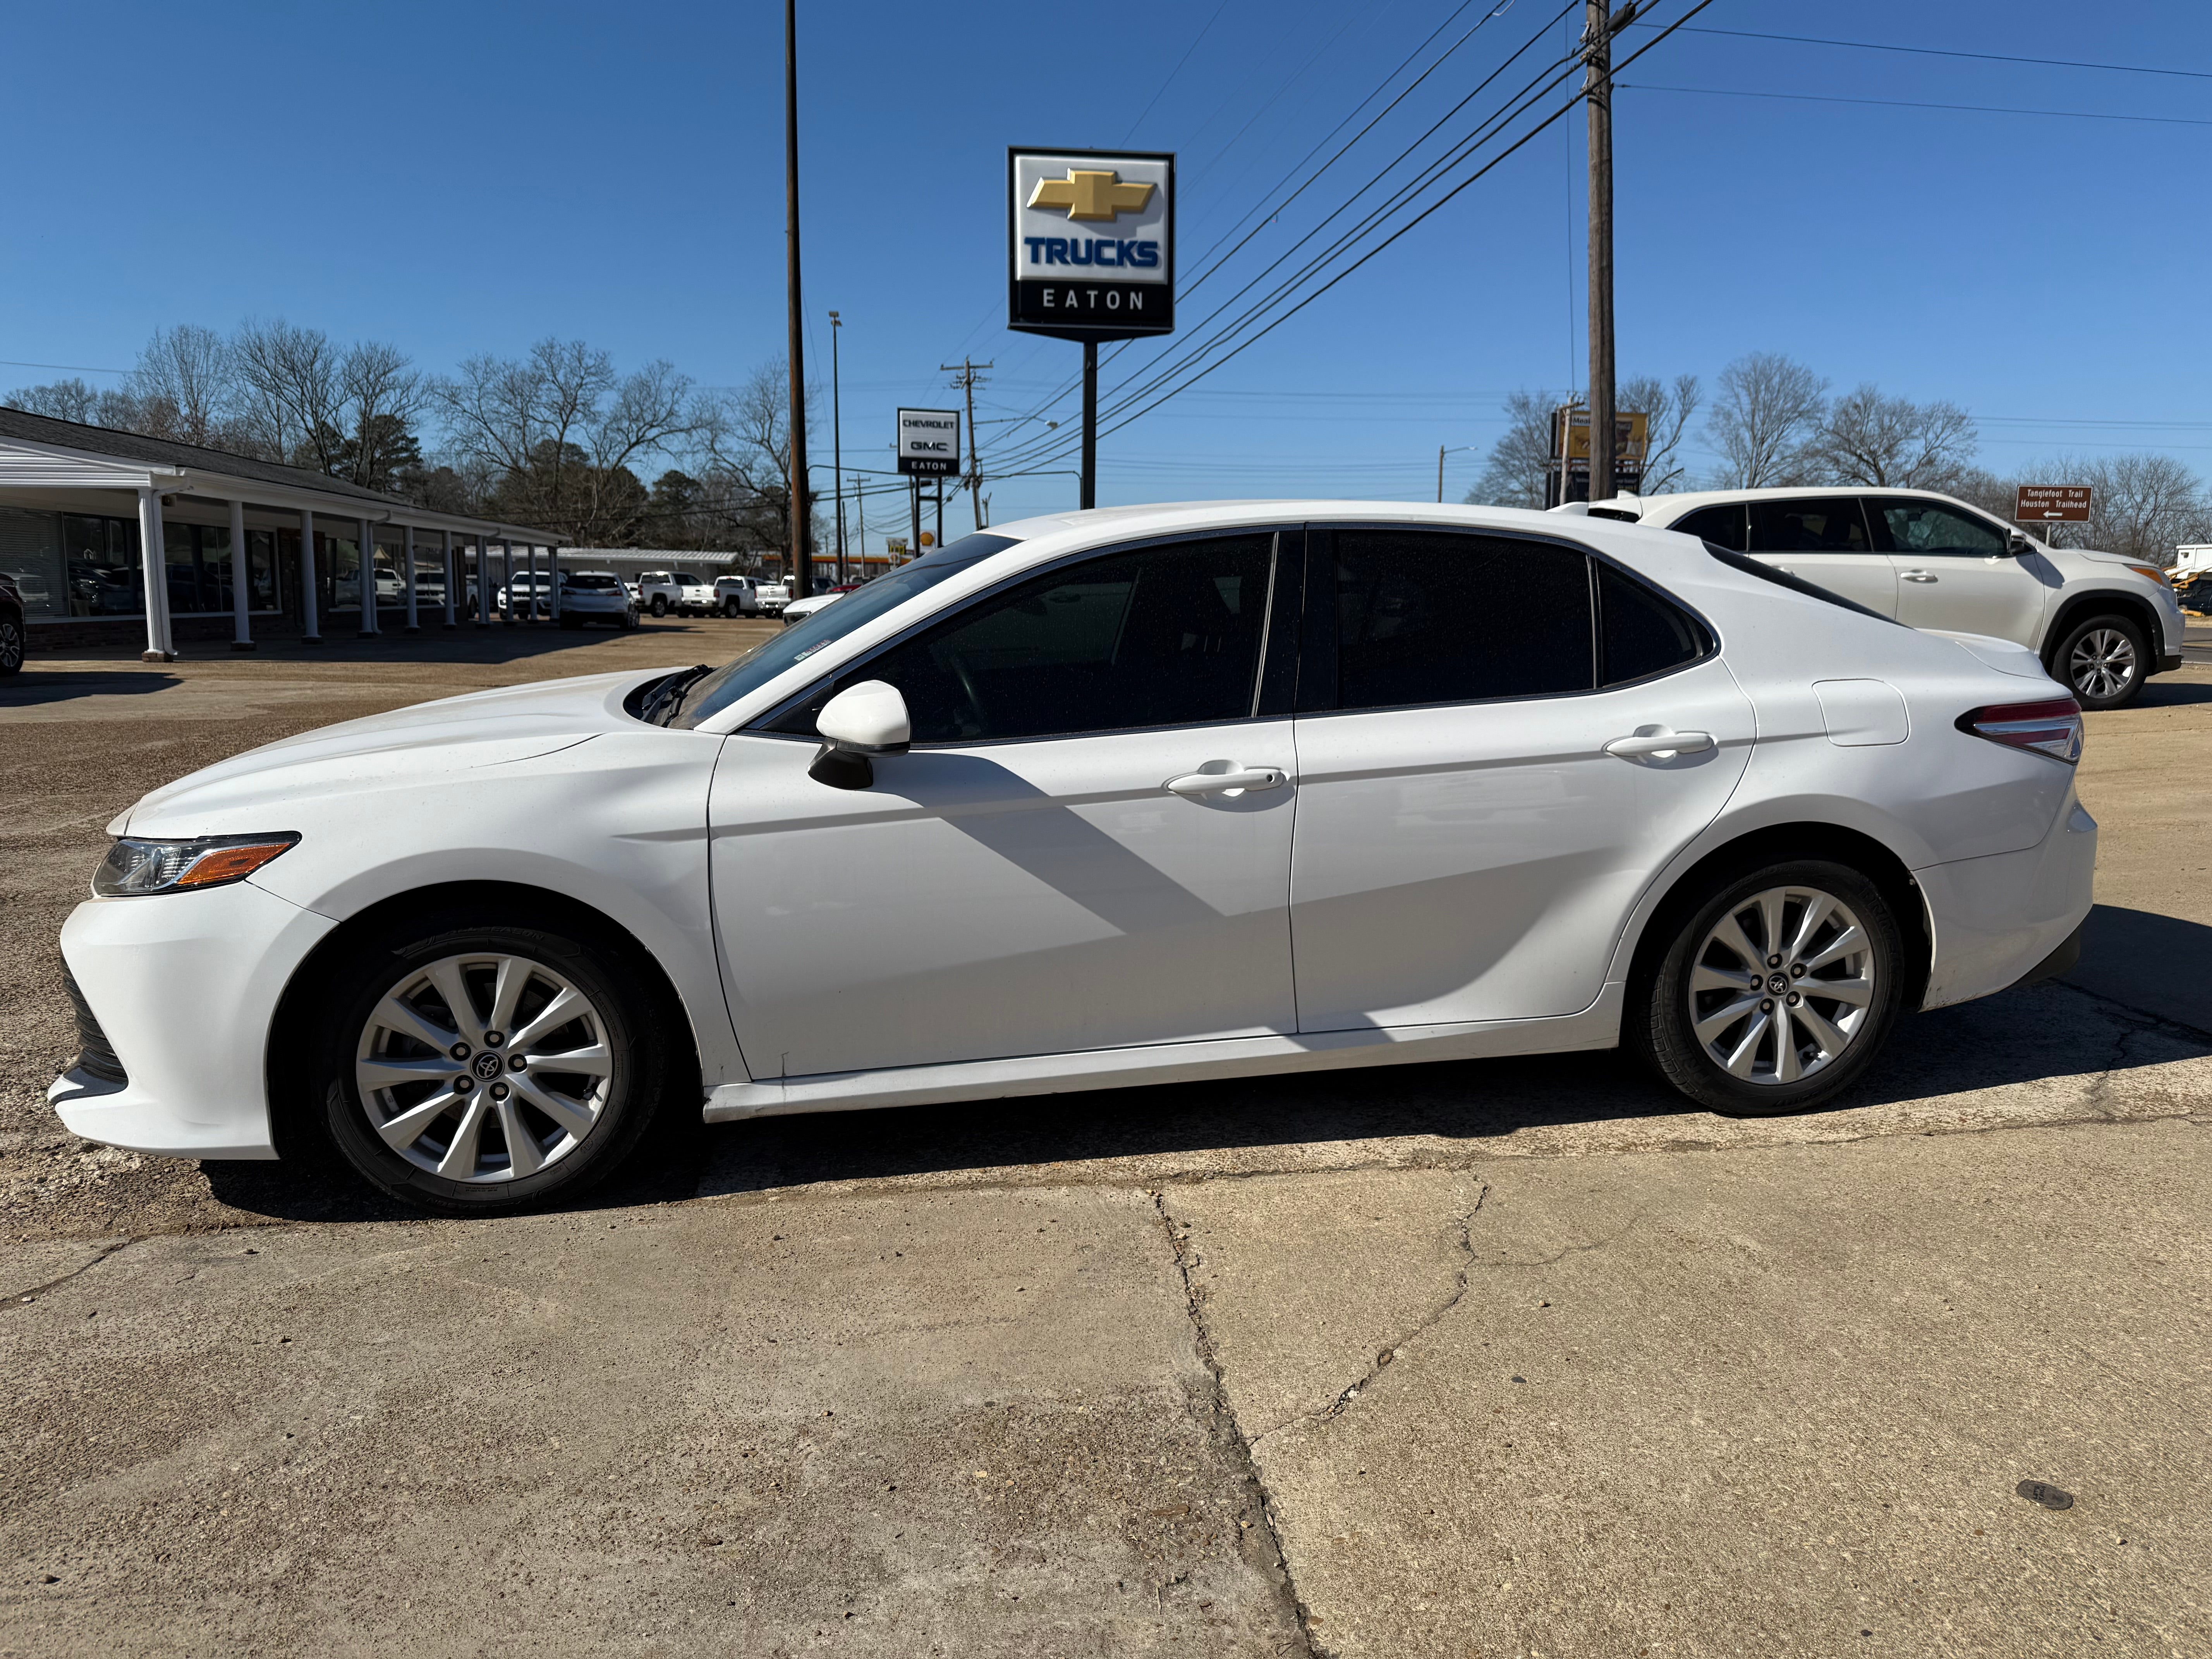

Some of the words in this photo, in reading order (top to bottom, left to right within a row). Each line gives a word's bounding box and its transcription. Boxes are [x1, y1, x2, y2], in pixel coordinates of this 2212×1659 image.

[1024, 237, 1158, 267] TRUCKS
[1042, 289, 1143, 310] EATON
[902, 419, 954, 429] CHEVROLET
[910, 441, 948, 451] GMC
[912, 461, 946, 471] EATON
[2027, 489, 2063, 499] Tanglefoot
[2068, 489, 2083, 498] Trail
[2021, 499, 2049, 508] Houston
[2056, 500, 2087, 508] Trailhead
[481, 926, 544, 941] SEASON
